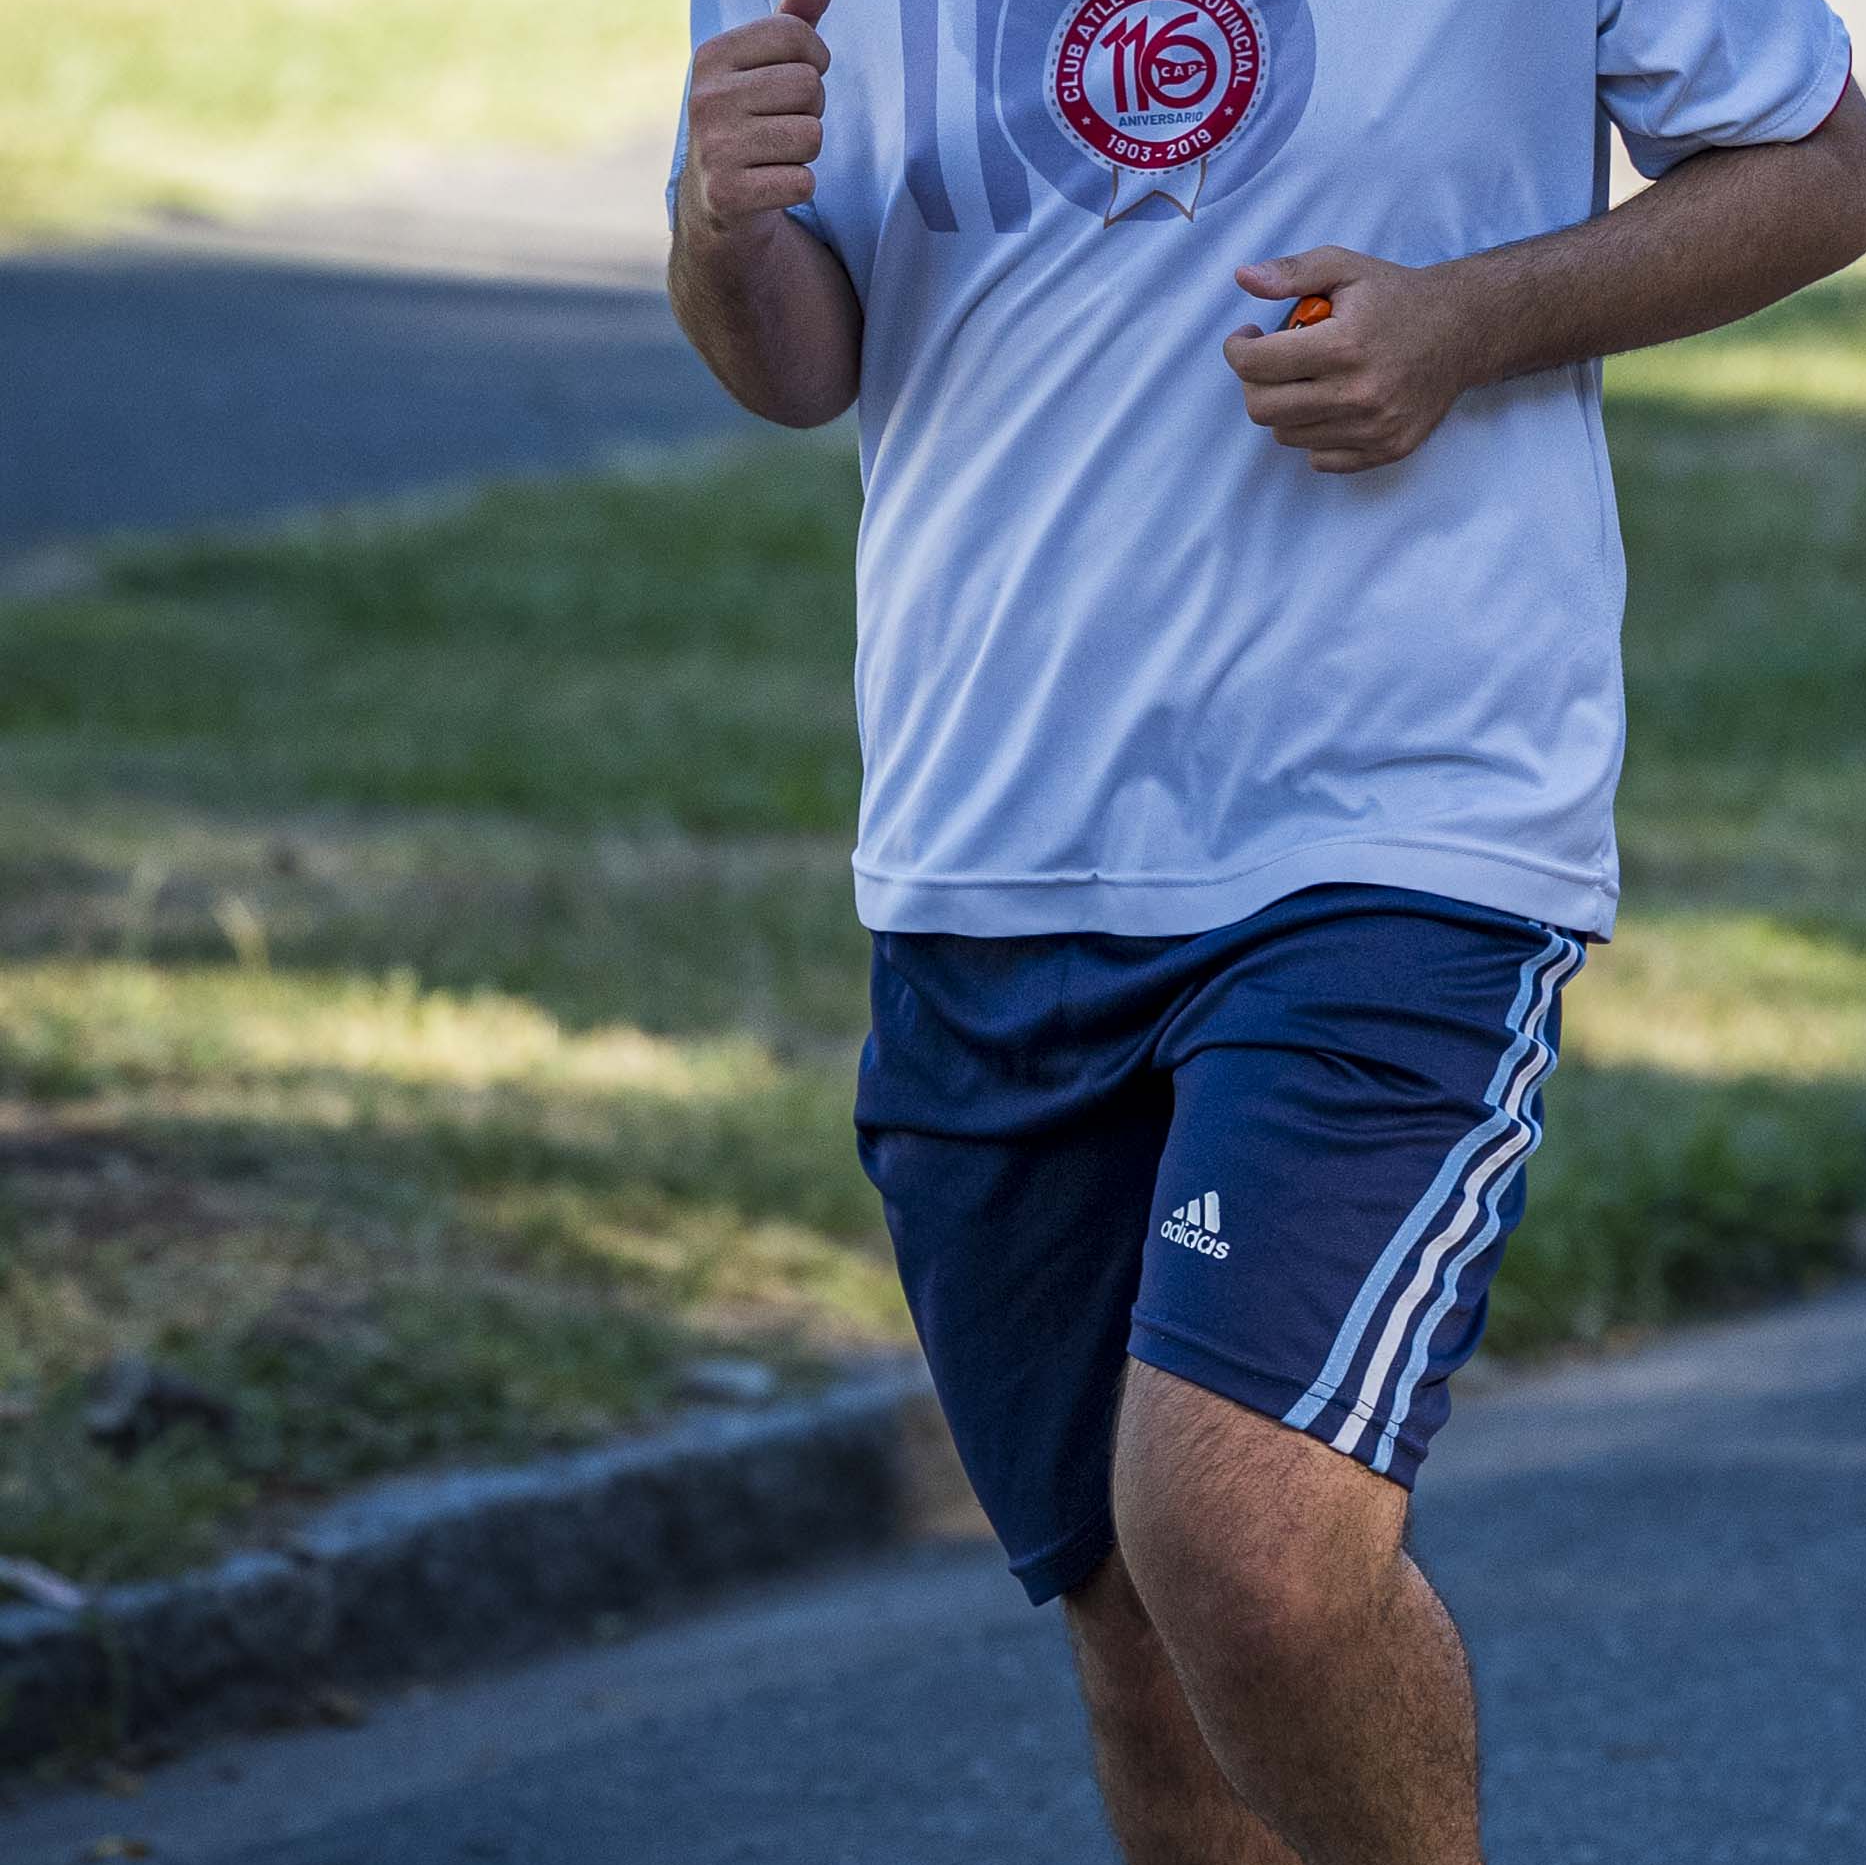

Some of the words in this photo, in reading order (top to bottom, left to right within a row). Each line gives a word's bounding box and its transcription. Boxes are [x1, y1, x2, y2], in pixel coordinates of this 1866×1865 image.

[1061, 43, 1085, 102] CLUB
[1100, 11, 1218, 113] 116
[1160, 63, 1198, 78] CAP
[1118, 110, 1204, 127] ANIVERSARIO
[1160, 1220, 1231, 1260] adidas
